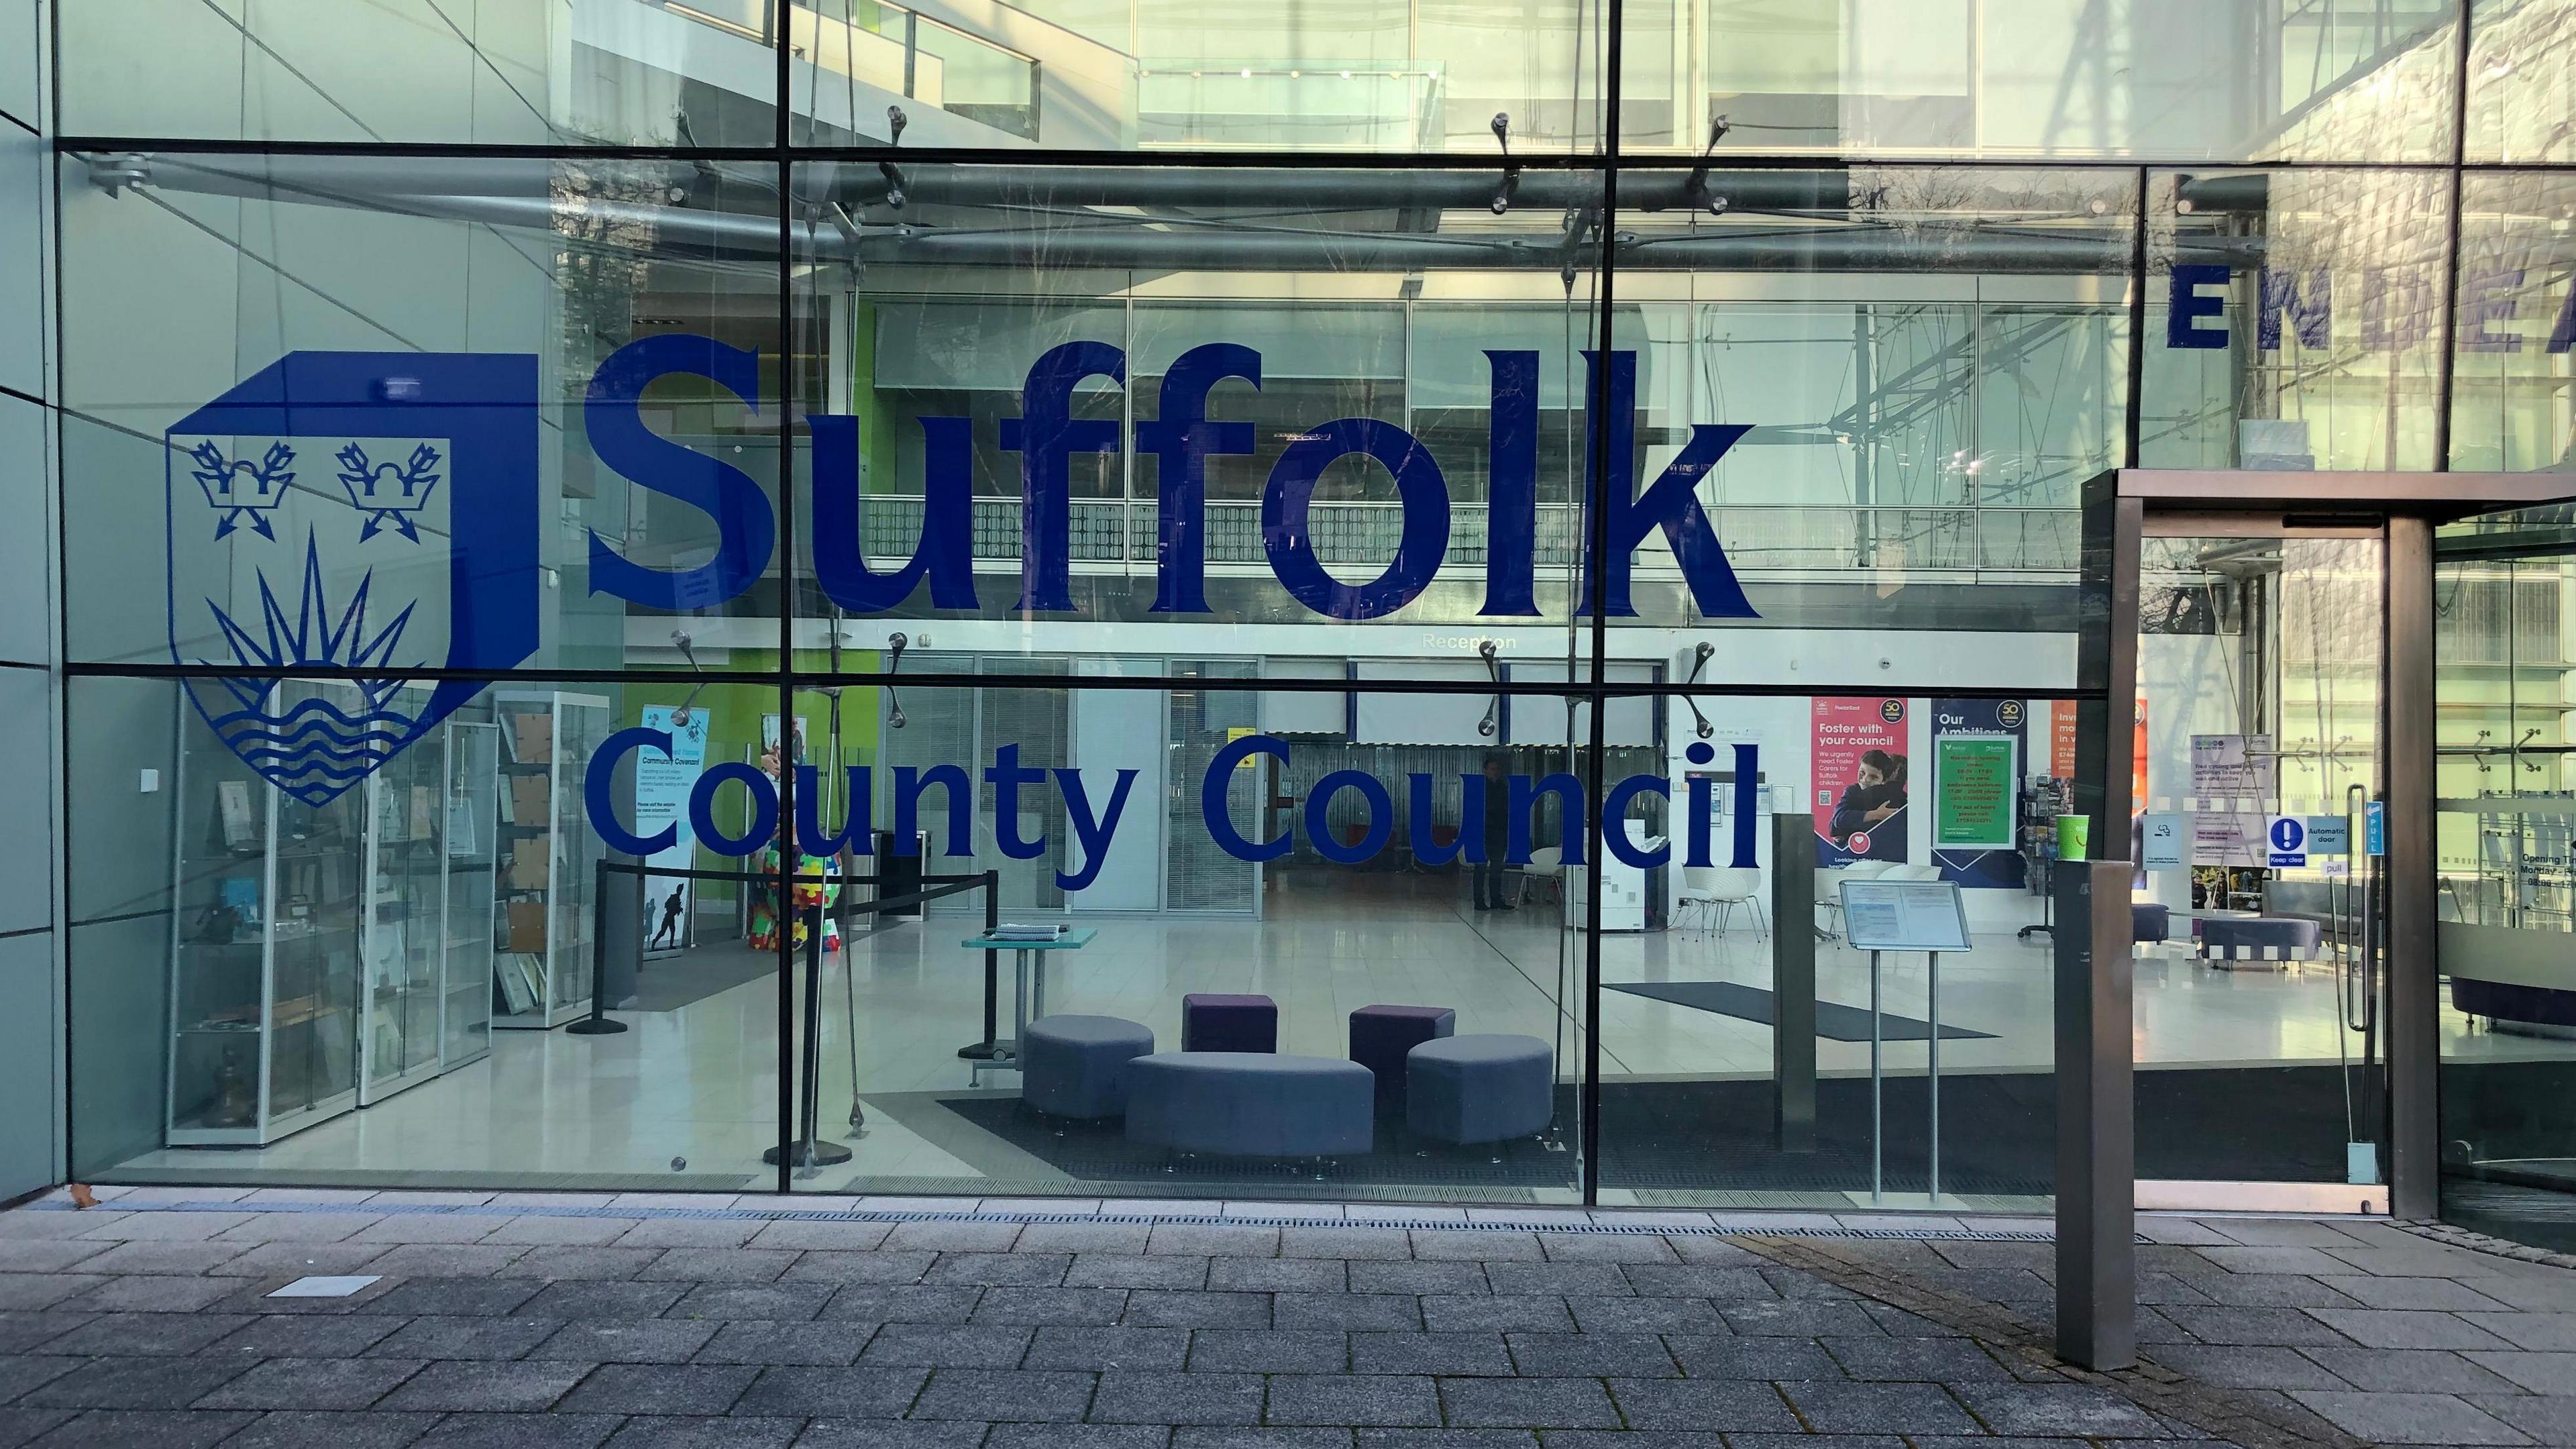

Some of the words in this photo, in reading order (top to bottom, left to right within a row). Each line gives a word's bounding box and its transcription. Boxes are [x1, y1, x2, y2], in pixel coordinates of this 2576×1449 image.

[584, 333, 1763, 620] Suffolk
[2002, 704, 2019, 714] 50
[1939, 714, 1964, 724] Our
[1819, 723, 1855, 733] Foster
[1858, 724, 1882, 733] with
[1819, 737, 1846, 747] your
[1849, 736, 1893, 745] council
[642, 757, 674, 765] Community
[584, 727, 1139, 891] County
[1201, 735, 1760, 869] Council
[2522, 853, 2561, 865] Opening
[2326, 865, 2342, 873] pull
